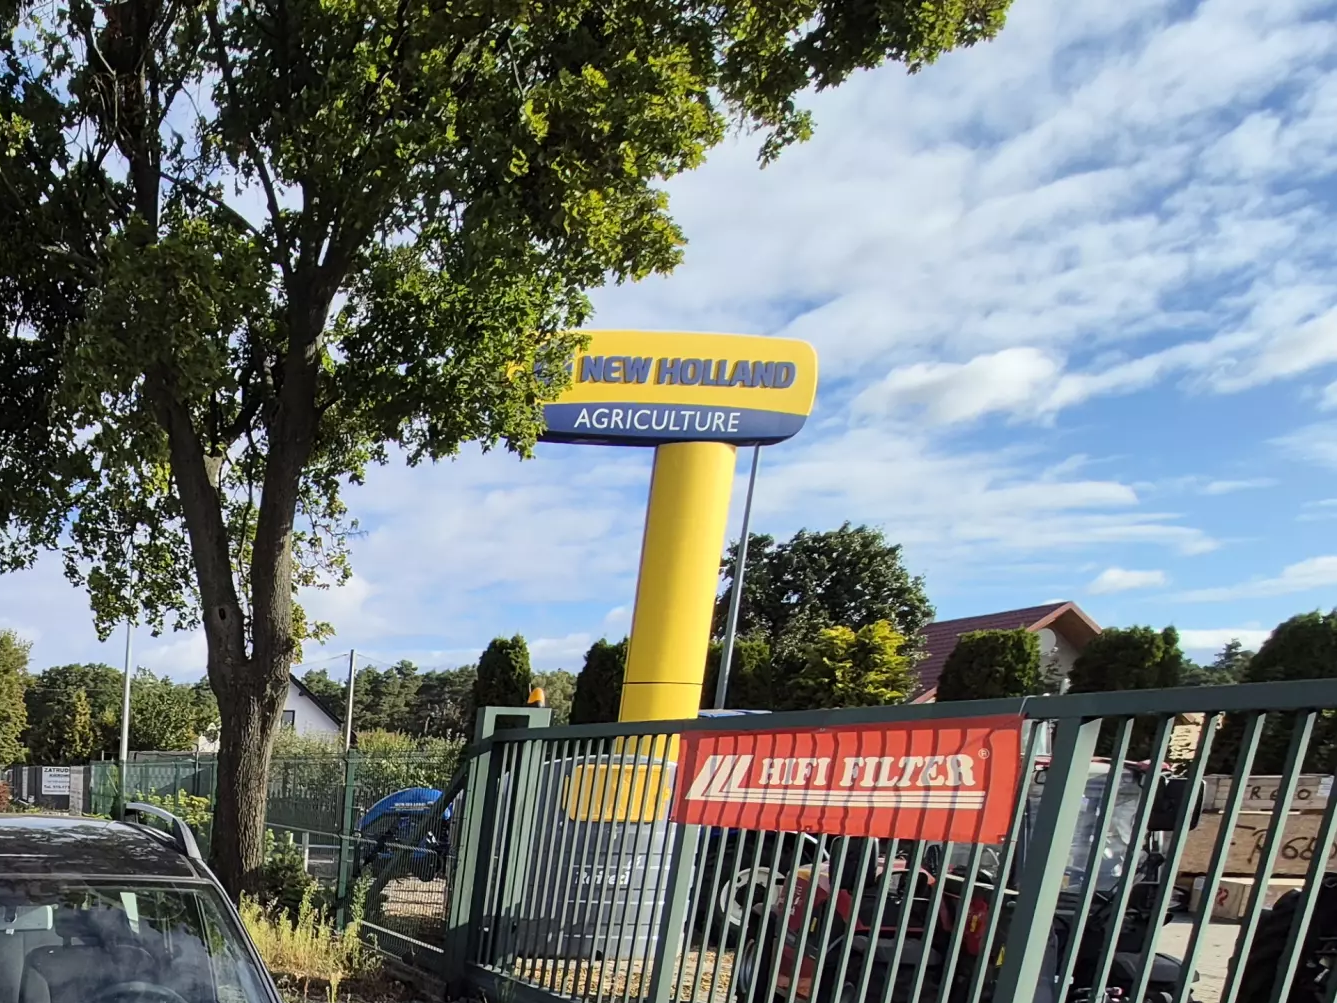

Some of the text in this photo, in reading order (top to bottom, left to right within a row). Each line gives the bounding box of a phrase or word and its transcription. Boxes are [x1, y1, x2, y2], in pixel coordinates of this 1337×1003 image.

[580, 355, 796, 388] NEW HOLLAND
[574, 407, 741, 433] AGRICULTURE
[758, 753, 976, 788] HIFI FILTER
